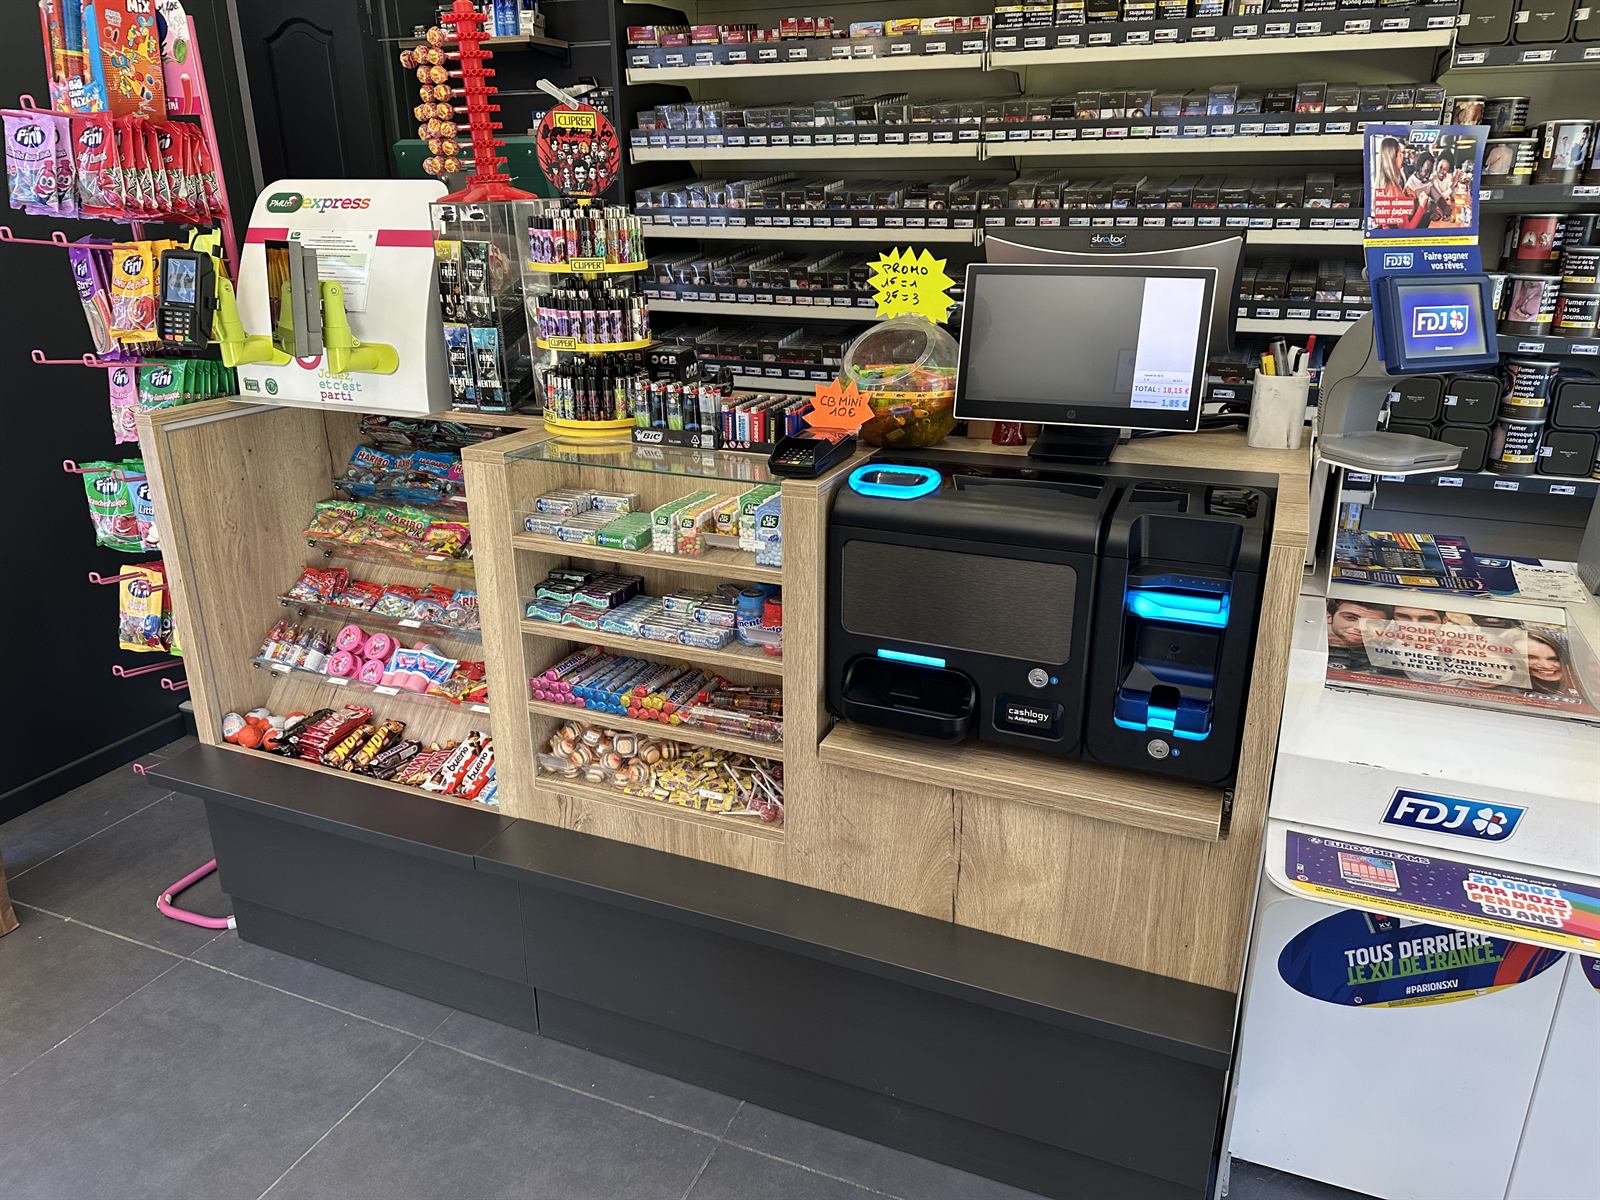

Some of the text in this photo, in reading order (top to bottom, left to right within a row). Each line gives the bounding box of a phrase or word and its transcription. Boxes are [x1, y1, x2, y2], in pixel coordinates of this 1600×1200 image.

[1411, 132, 1428, 143] FDJ
[302, 197, 372, 213] express
[125, 257, 142, 273] Fini
[573, 260, 602, 269] CLIPPER
[1386, 252, 1468, 267] FDJ Faire gagner
[1447, 260, 1464, 270] rêves
[882, 262, 928, 275] PROMO
[912, 292, 920, 306] 3
[1565, 298, 1586, 306] Fumer
[1417, 312, 1448, 331] FDJ
[651, 355, 677, 365] OCB
[150, 369, 172, 386] Fini
[320, 391, 353, 401] parti
[820, 396, 837, 407] CB
[1161, 399, 1180, 407] 1,85
[357, 451, 390, 468] HARIBO
[386, 512, 424, 530] HARIBO
[1375, 630, 1514, 654] VOUS DEVEZ AVOIR
[1400, 625, 1488, 643] POUR JOUER,
[1375, 648, 1401, 657] UNE
[1414, 643, 1432, 651] DE
[1456, 649, 1488, 658] ANS
[1409, 658, 1483, 672] PEUT VOUS
[1008, 708, 1049, 722] cashlogy
[446, 746, 469, 772] bueno
[467, 752, 488, 781] bueno
[1393, 796, 1470, 829] FDJ
[1472, 874, 1558, 898] 20 000€
[1466, 882, 1568, 909] PAR MOIS
[1471, 892, 1568, 918] PENDANT
[1485, 904, 1559, 926] 30 ANS
[1344, 943, 1394, 967] TOUS
[1348, 963, 1366, 982] LE
[1369, 959, 1394, 979] XV
[1400, 956, 1422, 976] DE
[1405, 979, 1459, 995] #PARIONSXV
